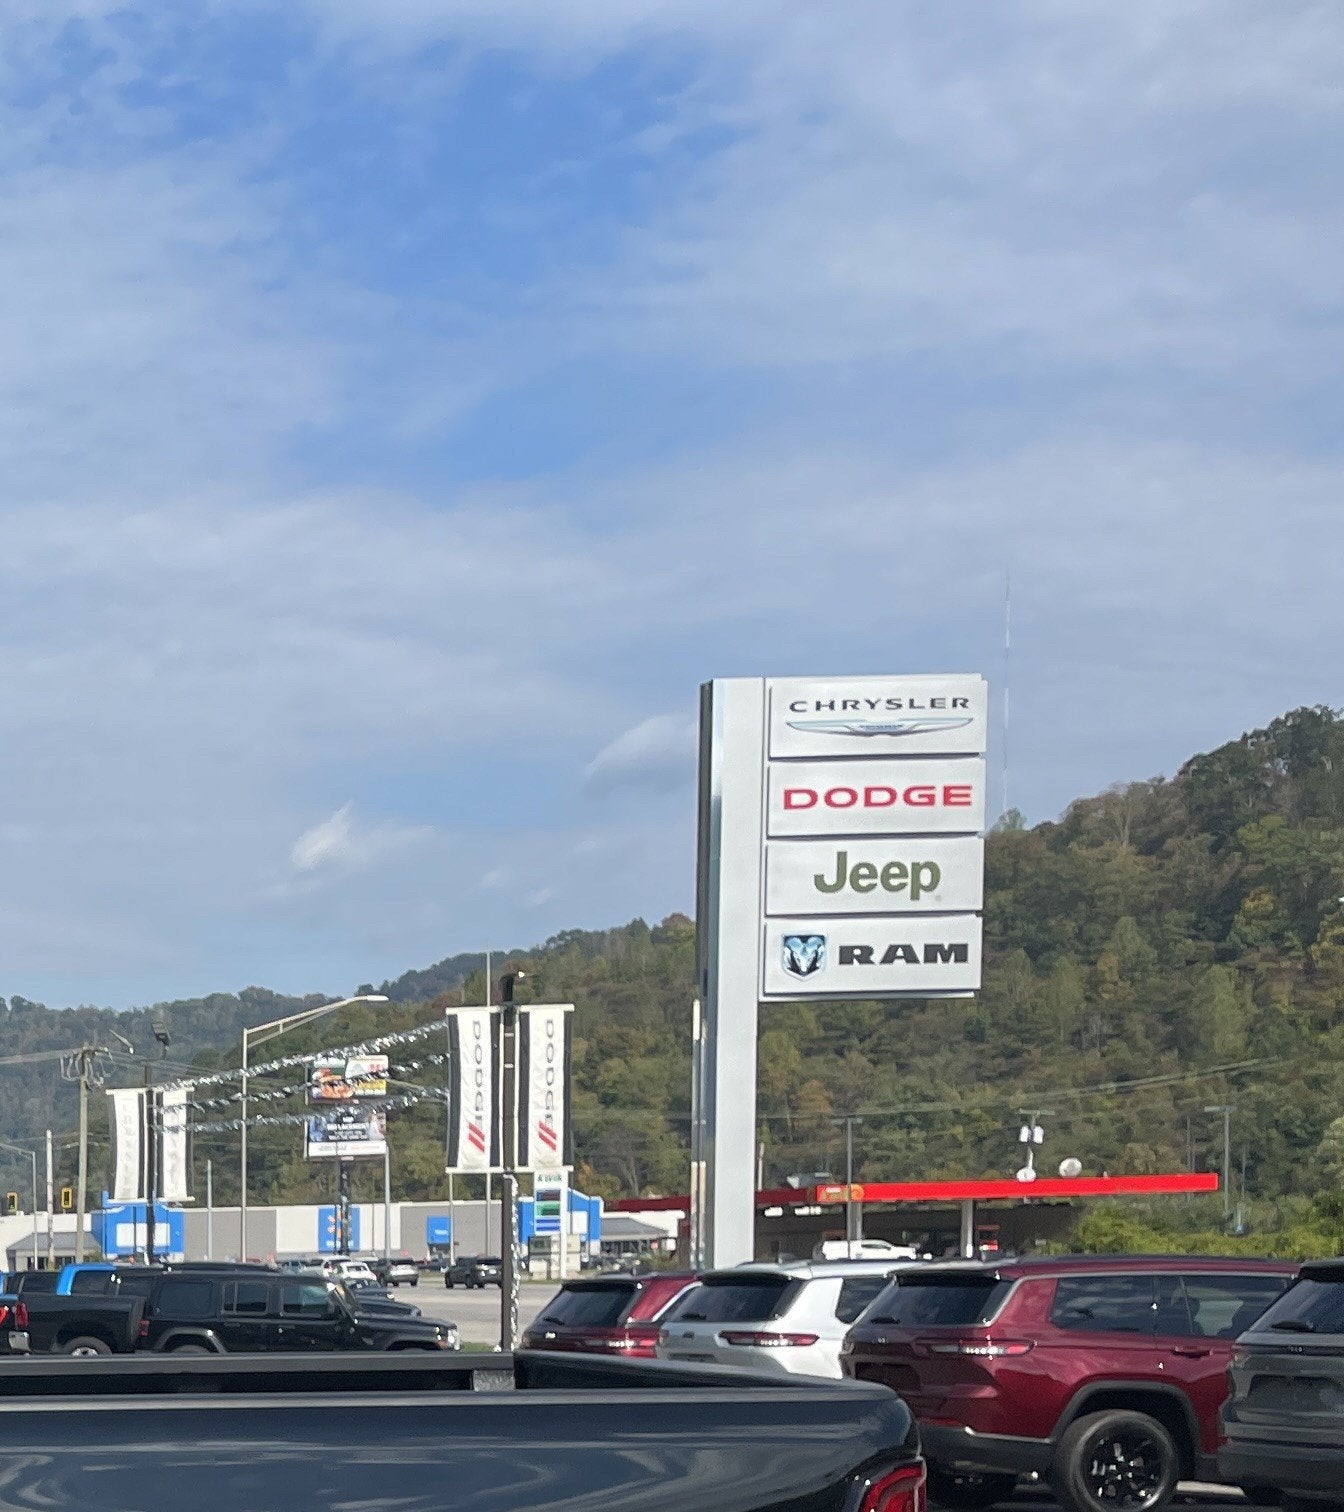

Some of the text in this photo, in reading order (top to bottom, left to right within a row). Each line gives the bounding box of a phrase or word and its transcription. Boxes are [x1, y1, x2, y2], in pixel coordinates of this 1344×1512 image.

[789, 696, 971, 713] CHRYSLER
[783, 784, 973, 811] DODGE
[813, 851, 941, 901] Jeep
[838, 942, 969, 966] RAM
